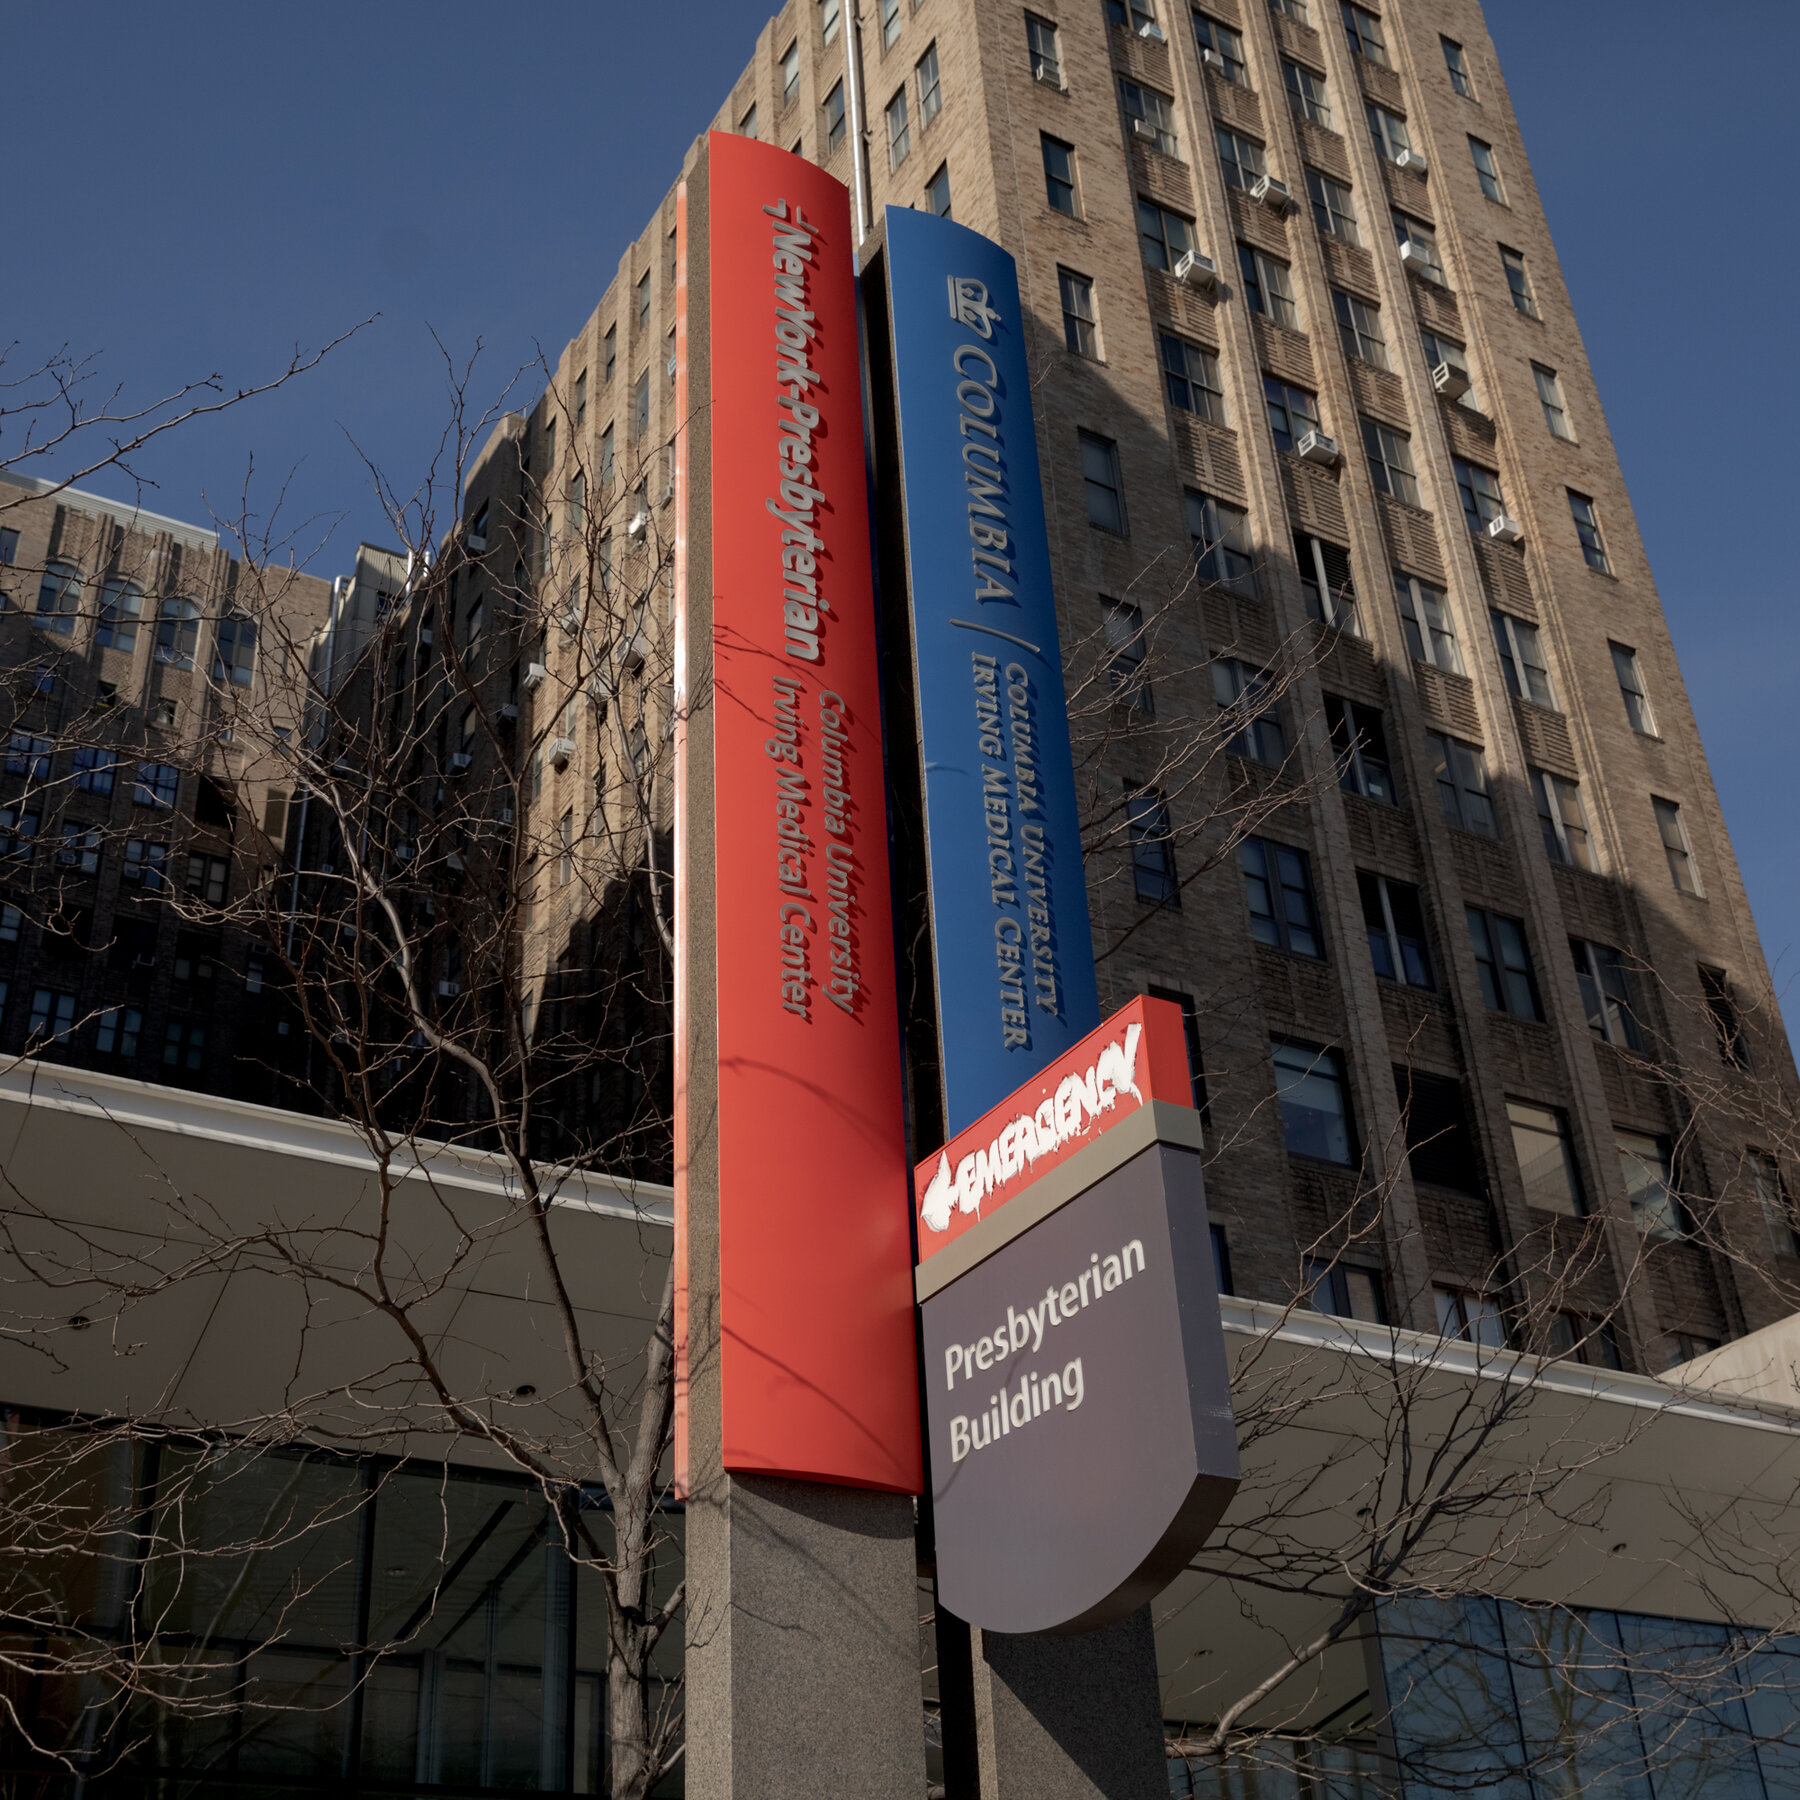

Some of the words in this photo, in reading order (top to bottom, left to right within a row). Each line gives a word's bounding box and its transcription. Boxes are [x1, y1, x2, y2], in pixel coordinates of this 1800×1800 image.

[766, 221, 830, 660] NewYork-Presbyterian
[953, 344, 1015, 602] COLUMBIA
[764, 675, 801, 763] Irving
[819, 690, 852, 834] Columbia
[971, 651, 1002, 757] IRVING
[1005, 662, 1040, 812] COLUMBIA
[776, 766, 811, 897] Medical
[981, 763, 1015, 906] MEDICAL
[779, 902, 812, 1019] Center
[822, 842, 861, 1014] University
[994, 916, 1028, 1053] CENTER
[1020, 823, 1059, 1016] UNIVERSITY
[956, 1023, 1142, 1222] EMERGENCY
[944, 1239, 1146, 1391] Presbyterian
[949, 1357, 1085, 1463] Building
